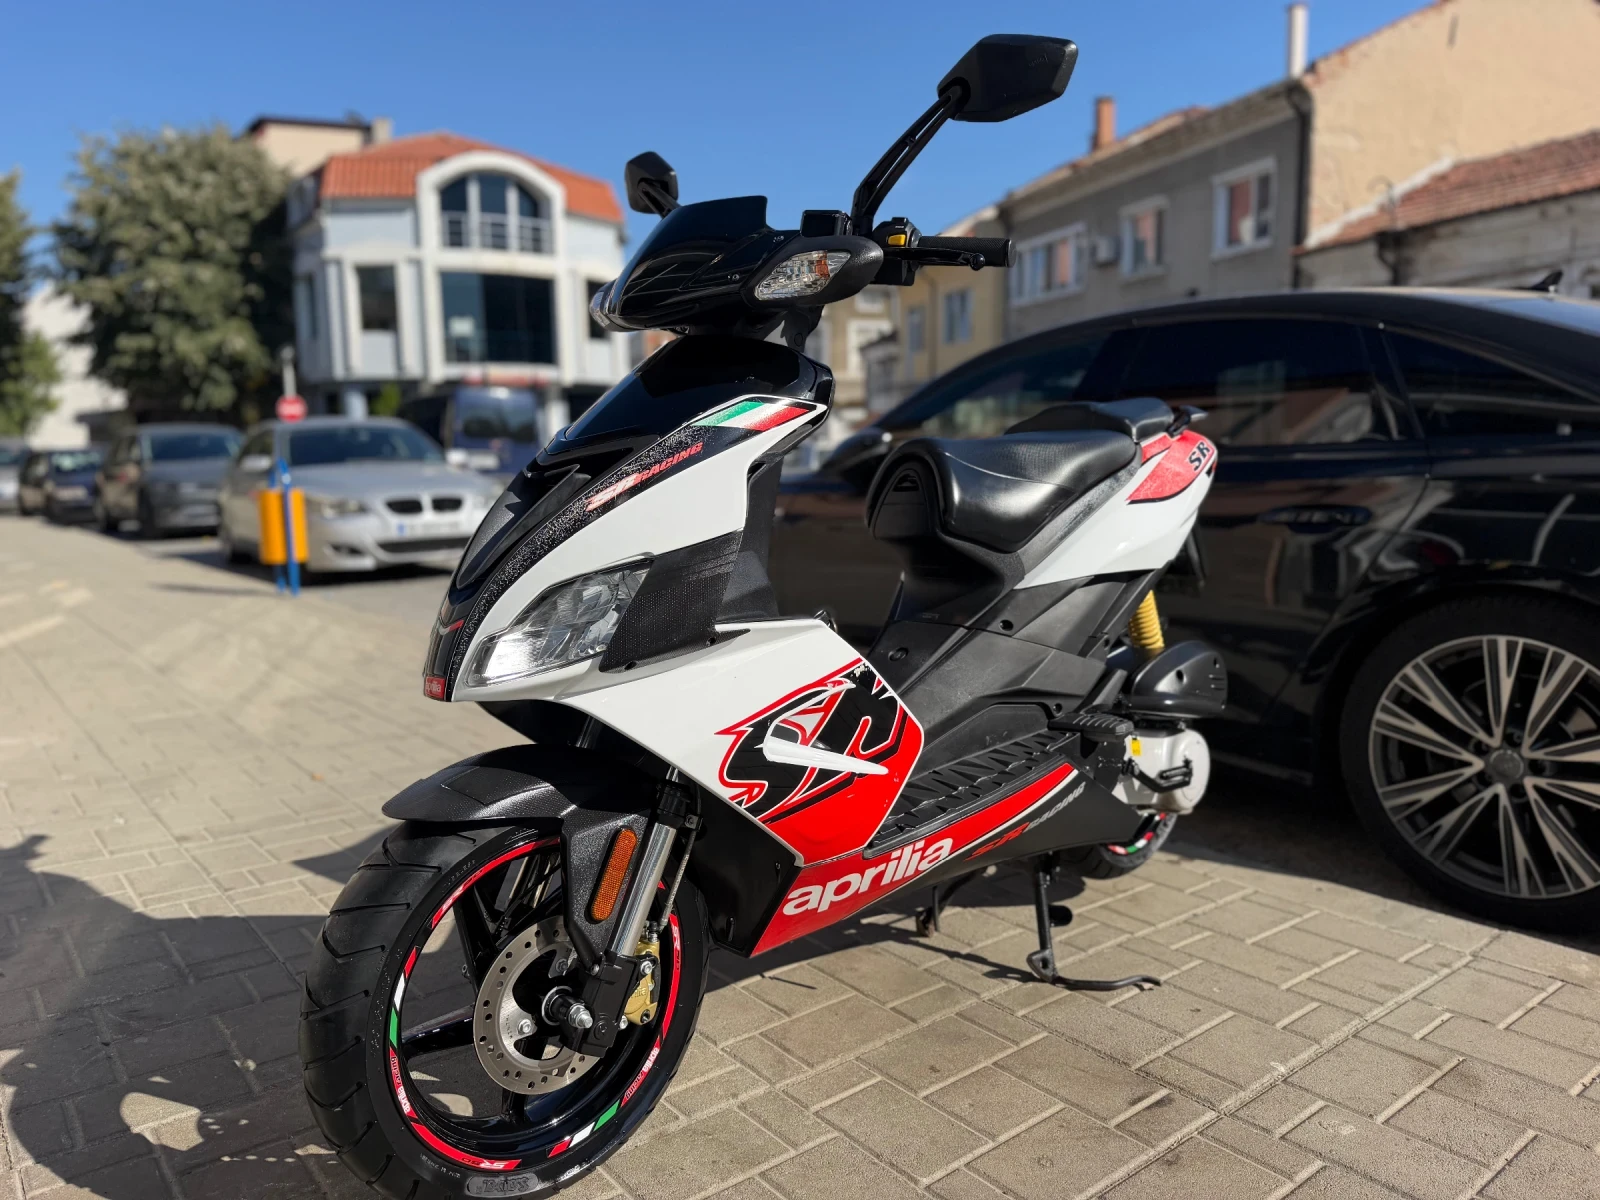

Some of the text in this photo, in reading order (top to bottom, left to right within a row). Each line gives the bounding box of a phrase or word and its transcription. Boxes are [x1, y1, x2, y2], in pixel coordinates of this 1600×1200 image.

[637, 442, 704, 482] RACING
[1188, 442, 1211, 471] SR
[782, 838, 953, 916] aprilia
[642, 1047, 660, 1072] aprilia
[397, 1086, 411, 1114] aprilia
